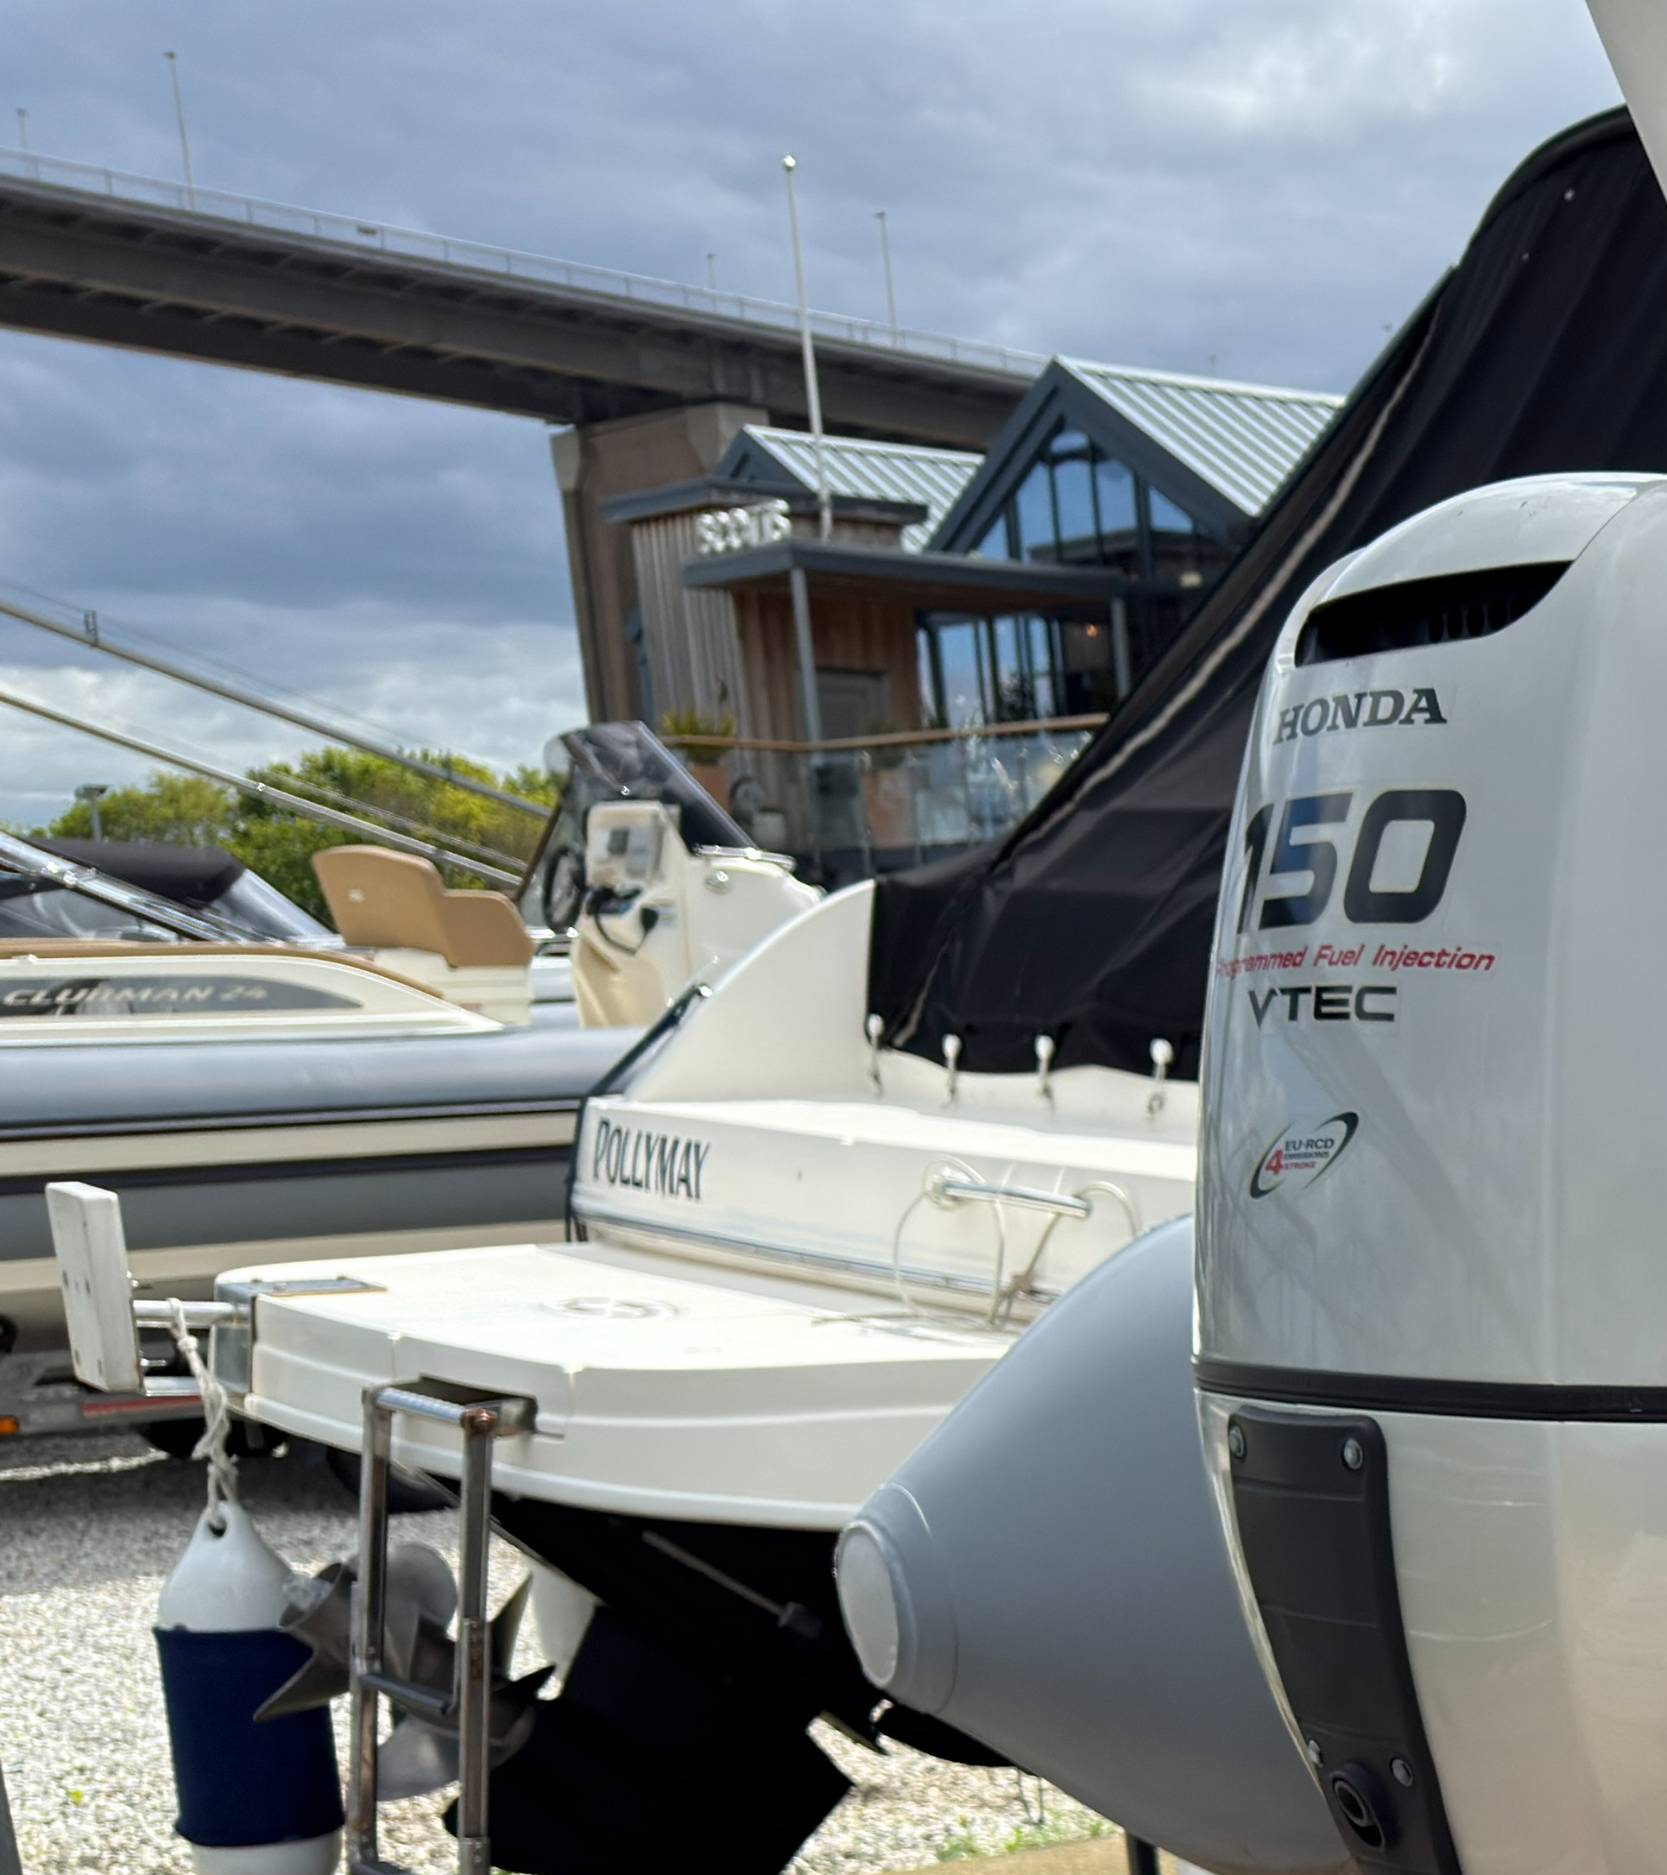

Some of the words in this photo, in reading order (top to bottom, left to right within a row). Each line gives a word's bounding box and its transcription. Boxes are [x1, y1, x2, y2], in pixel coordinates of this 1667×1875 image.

[1273, 688, 1447, 745] HONDA
[1236, 789, 1468, 935] 150
[1313, 944, 1366, 968] Fuel
[1371, 944, 1497, 972] Injection
[1248, 985, 1398, 1029] VTEC
[593, 1118, 711, 1201] POLLYMAY
[1265, 1148, 1284, 1176] 4
